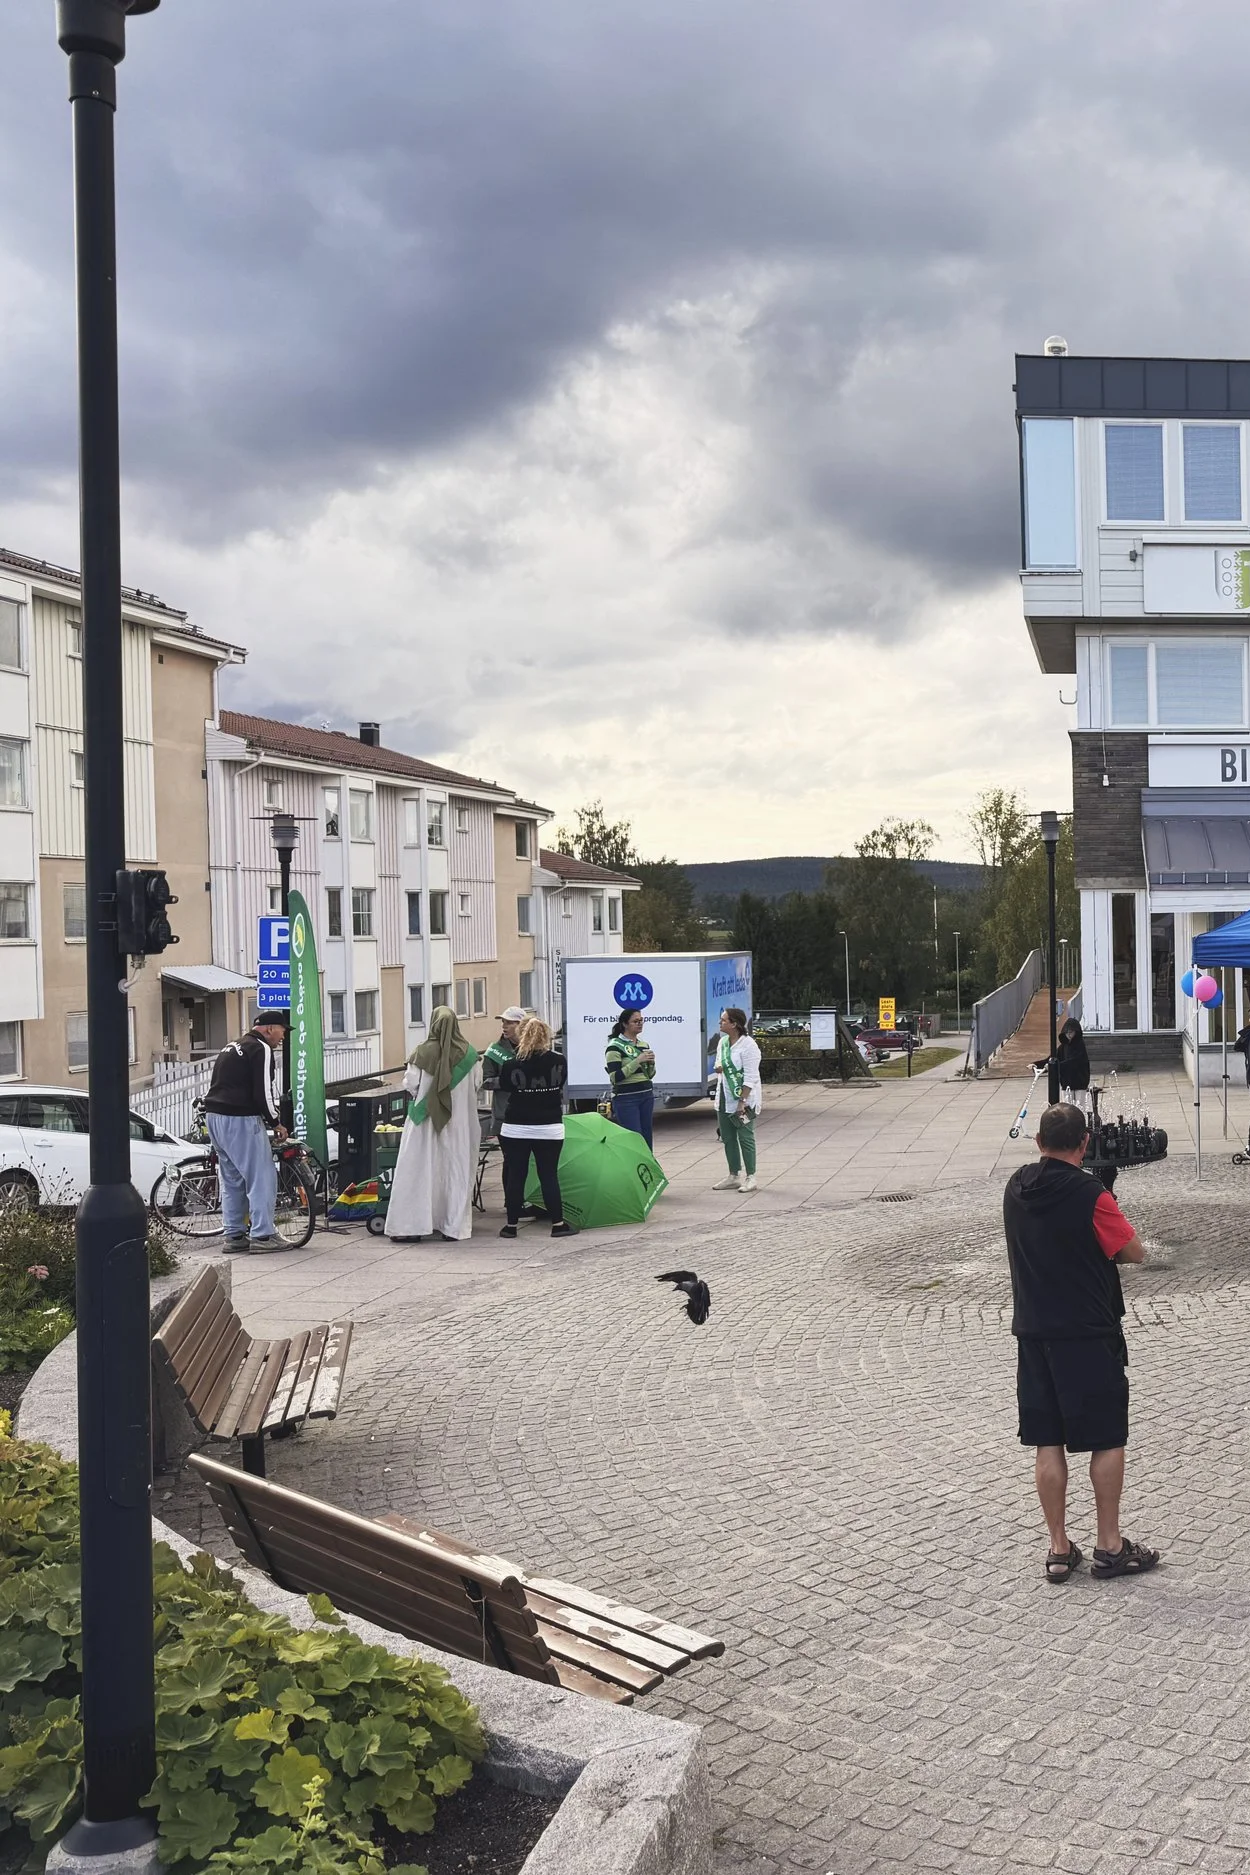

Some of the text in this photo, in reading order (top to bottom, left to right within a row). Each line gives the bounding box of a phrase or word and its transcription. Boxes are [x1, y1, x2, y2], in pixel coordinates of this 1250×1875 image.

[270, 921, 289, 957] P
[262, 970, 277, 979] 20
[712, 975, 726, 998] Kraft
[735, 973, 746, 993] leda
[269, 994, 291, 1002] plats
[583, 1015, 597, 1023] För
[643, 1015, 684, 1024] orgondag.
